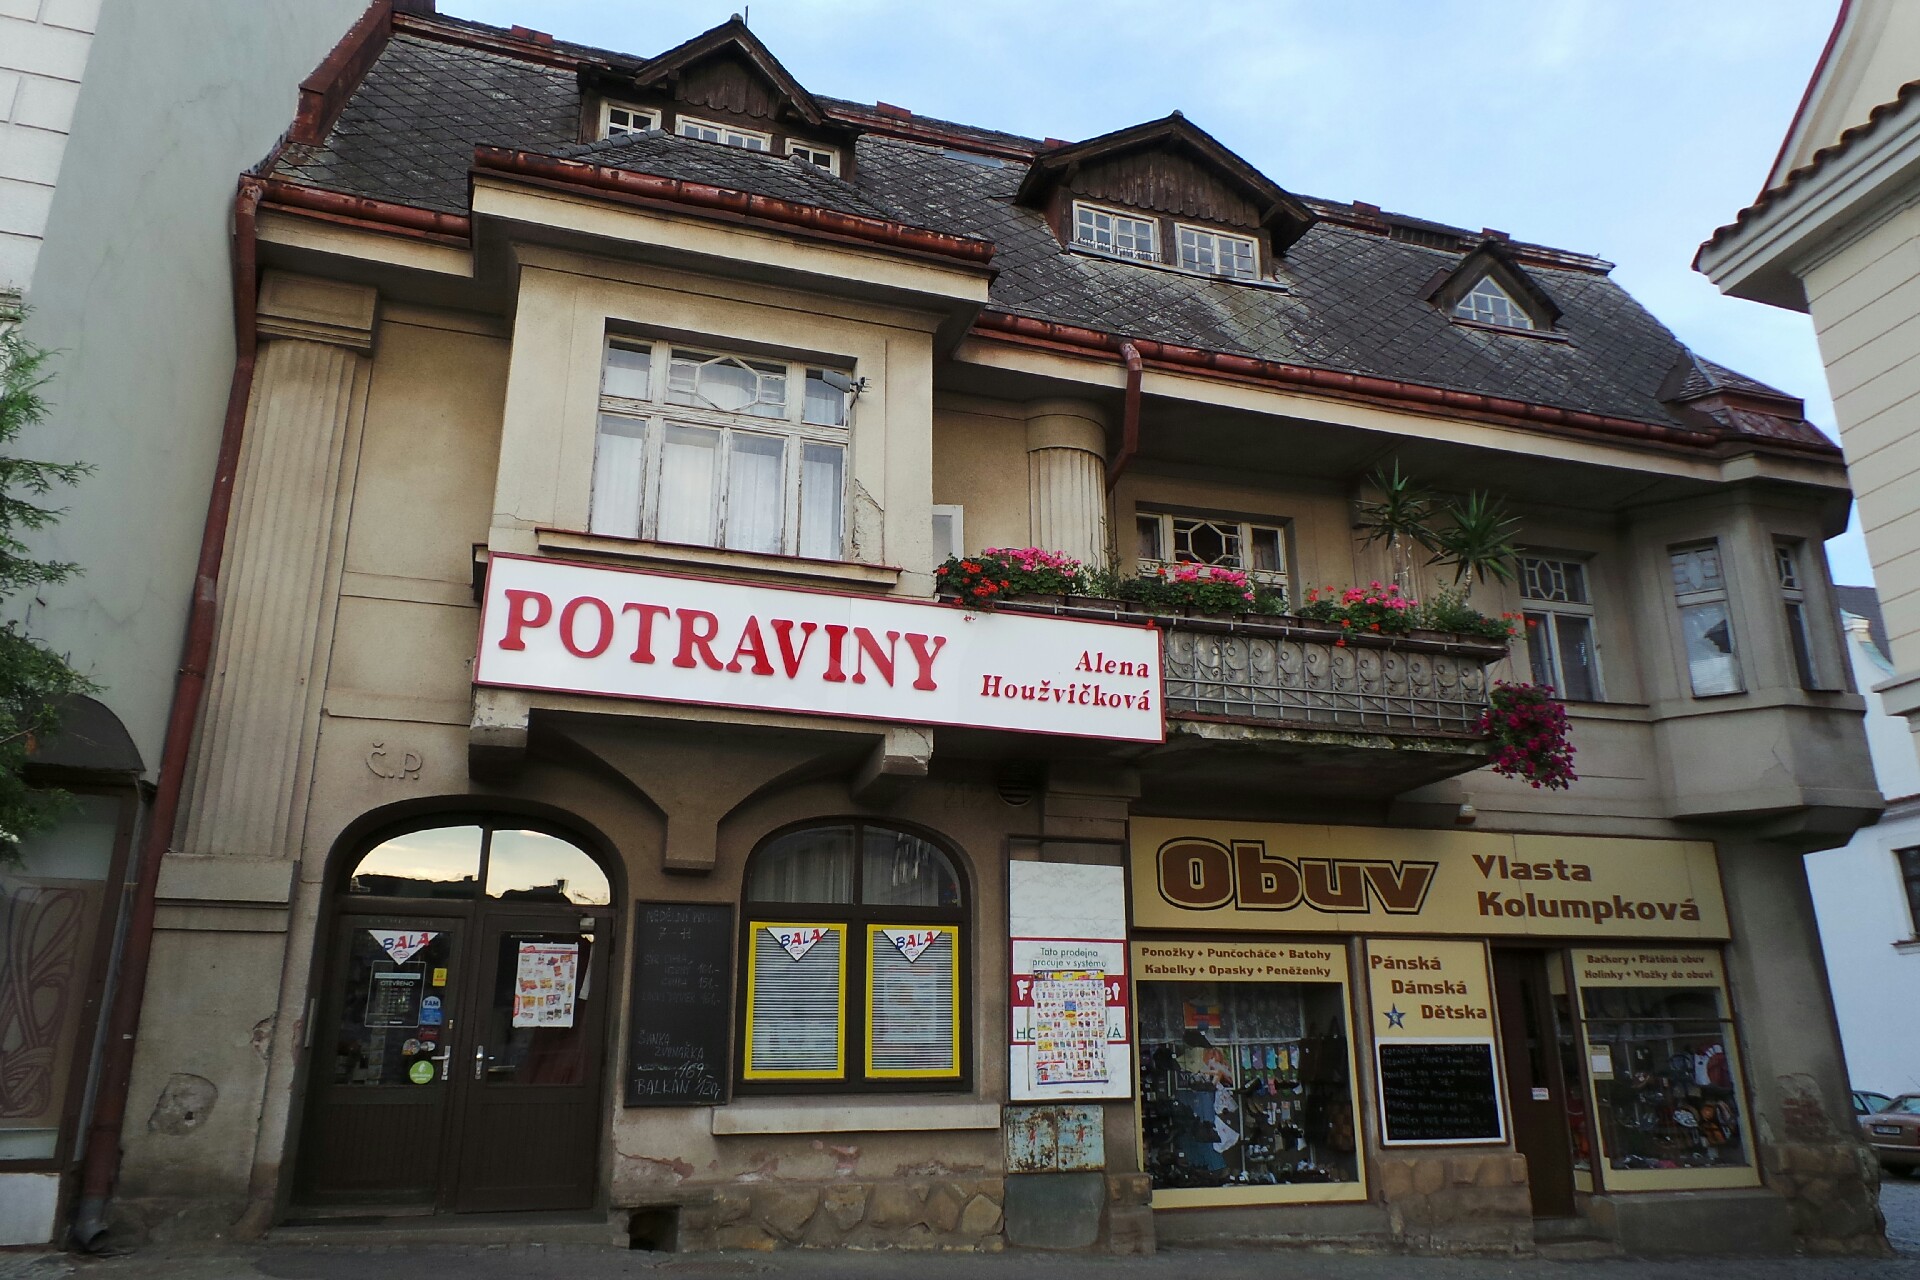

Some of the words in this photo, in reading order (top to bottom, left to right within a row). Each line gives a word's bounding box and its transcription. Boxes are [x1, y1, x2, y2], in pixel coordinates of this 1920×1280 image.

[499, 588, 946, 691] POTRAVINY
[1074, 650, 1151, 679] Alena
[981, 674, 1152, 713] Houžvičková
[1156, 837, 1438, 915] Obuv
[1472, 854, 1592, 882] Vlasta
[1477, 890, 1701, 925] Kolumpková
[383, 932, 430, 951] BALA
[780, 929, 823, 948] BALA
[895, 931, 935, 950] BALA
[1040, 947, 1058, 956] Tato
[1061, 947, 1098, 960] prodejna
[1141, 947, 1194, 959] Ponožky
[1207, 948, 1277, 958] Punčocháče
[1288, 949, 1331, 961] Batohy
[1586, 954, 1629, 965] Bačkory
[1639, 954, 1678, 964] Plátěná
[1681, 955, 1705, 964] obuv
[1032, 959, 1063, 968] pracuje
[1145, 964, 1196, 975] Kabelky
[1209, 965, 1254, 976] Opasky
[1266, 965, 1331, 977] Peněženky
[1370, 955, 1442, 970] Pánská
[1584, 970, 1623, 980] Holinky
[1633, 970, 1668, 980] Vložky
[1672, 970, 1683, 979] do
[1391, 979, 1467, 995] Dámská
[1421, 1004, 1487, 1019] Dětska
